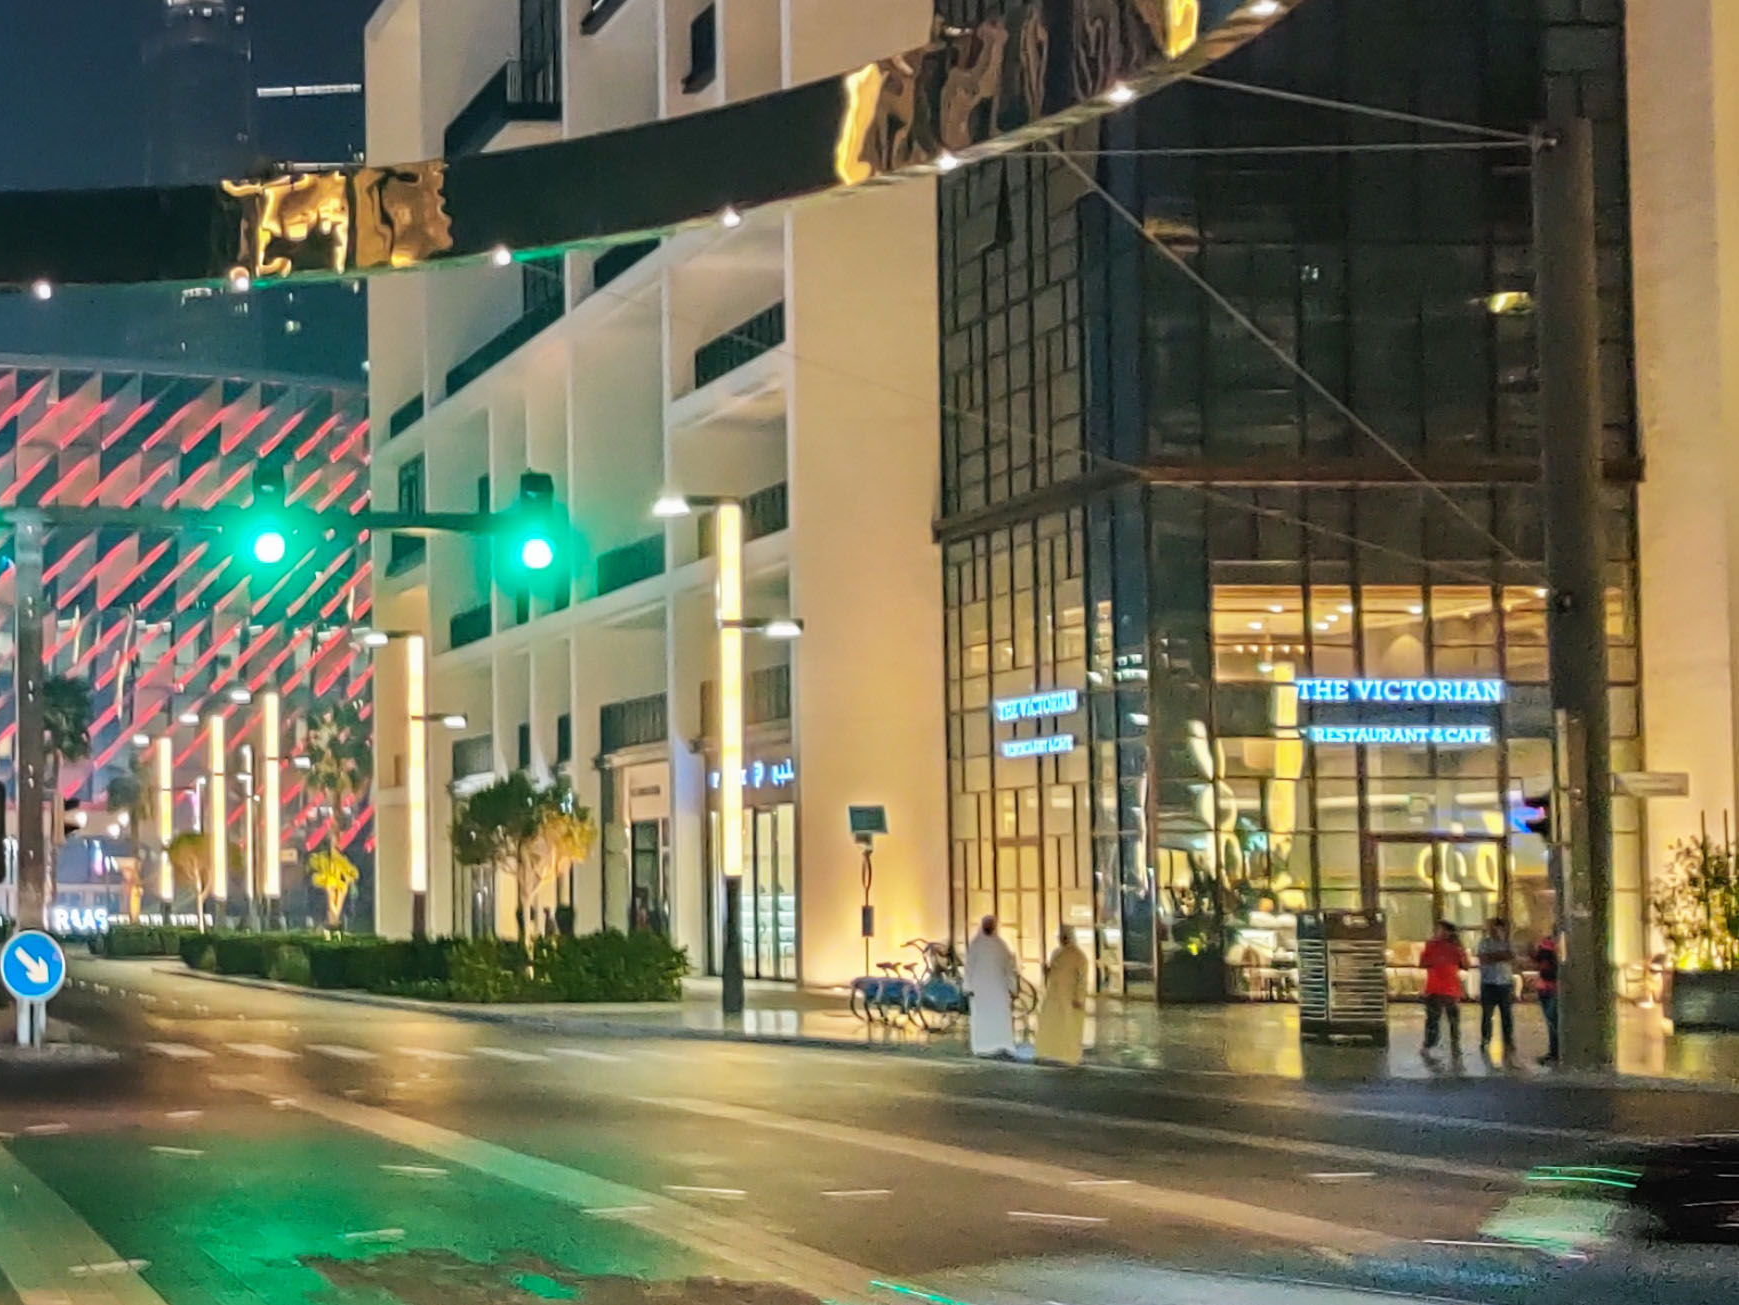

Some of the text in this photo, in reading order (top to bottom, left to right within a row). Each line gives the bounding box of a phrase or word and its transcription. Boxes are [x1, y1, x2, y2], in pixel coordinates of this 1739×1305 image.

[1297, 679, 1503, 701] THE VICTORIAN
[1314, 727, 1429, 743] RESTAURANT
